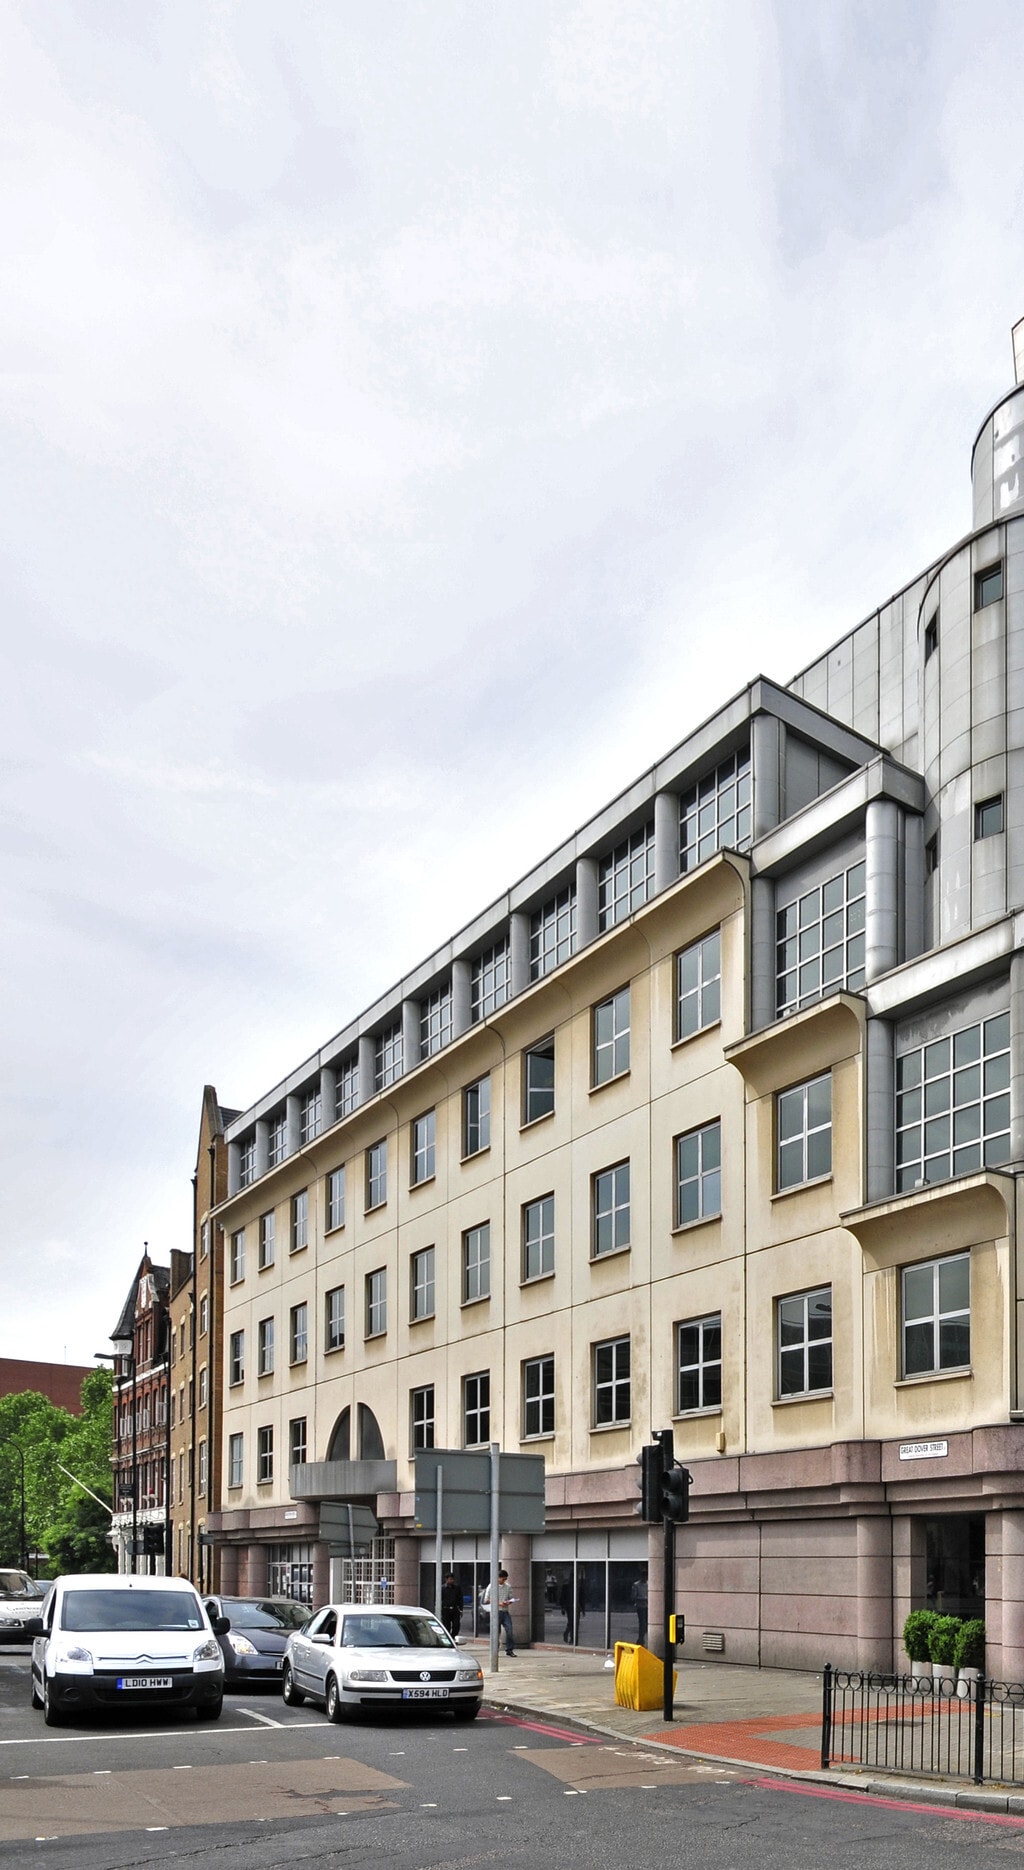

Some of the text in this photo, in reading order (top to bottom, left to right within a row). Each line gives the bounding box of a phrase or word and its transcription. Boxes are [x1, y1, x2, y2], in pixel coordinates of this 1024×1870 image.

[900, 1442, 943, 1454] GREAT DOVER STREET
[125, 1678, 168, 1688] LD10 HWW
[408, 1690, 430, 1698] X594
